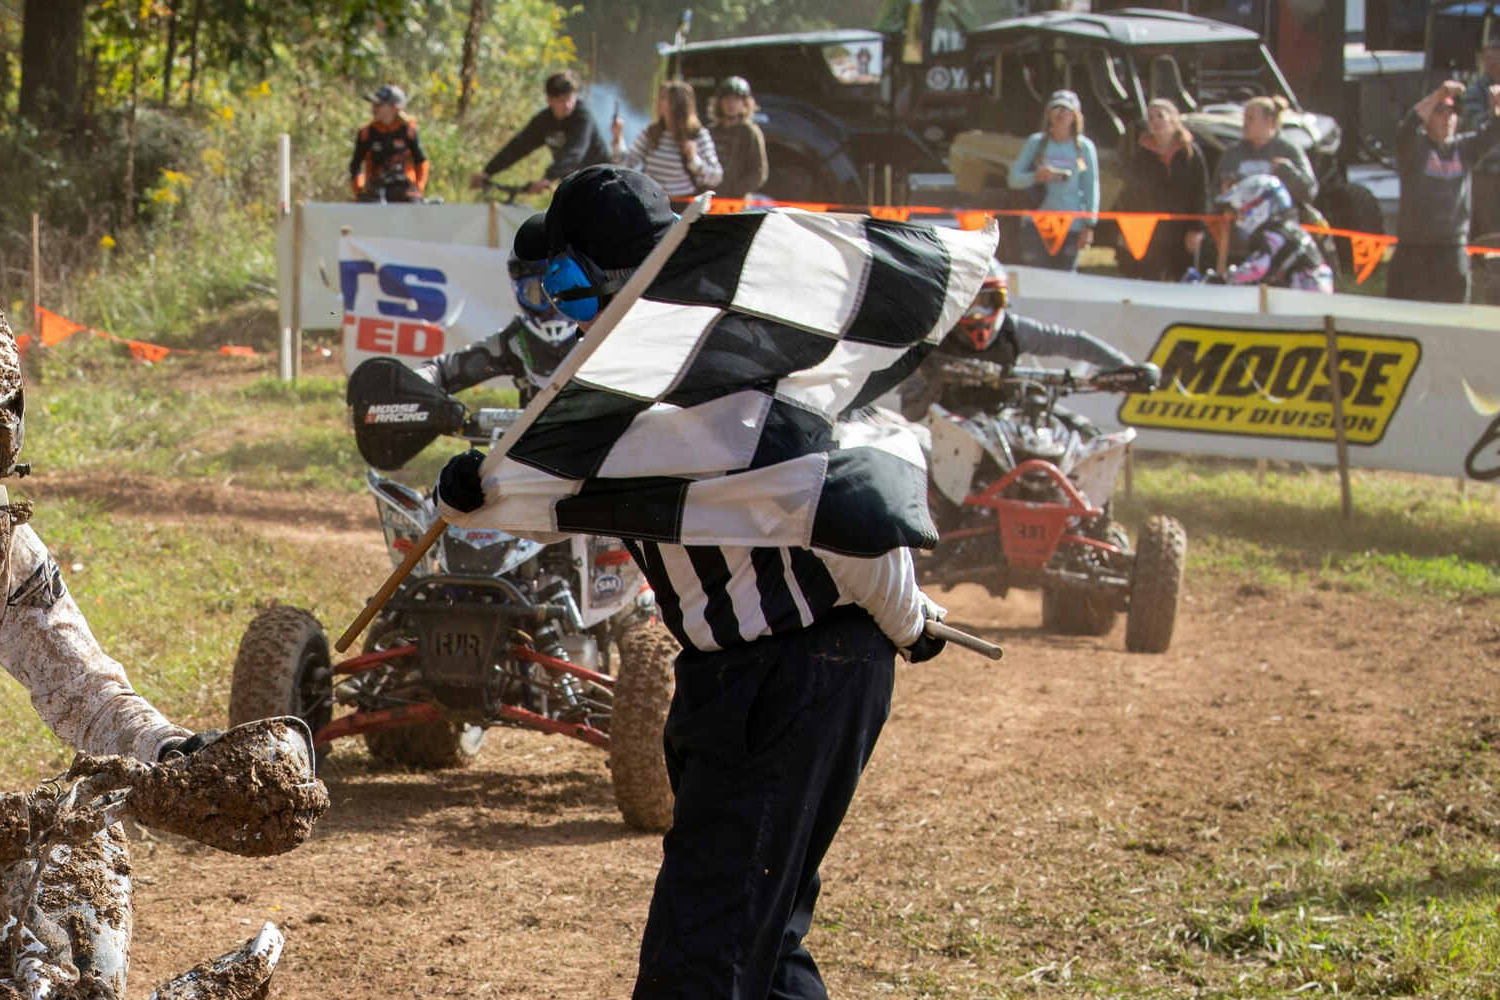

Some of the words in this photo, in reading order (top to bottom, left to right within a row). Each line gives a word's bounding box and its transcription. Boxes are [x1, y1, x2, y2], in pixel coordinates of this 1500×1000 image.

[1152, 339, 1403, 406] MOOSE
[368, 403, 420, 415] MOOSE
[374, 412, 430, 423] RACING
[1136, 399, 1246, 423] UTILITY
[1248, 408, 1376, 433] DIVISION
